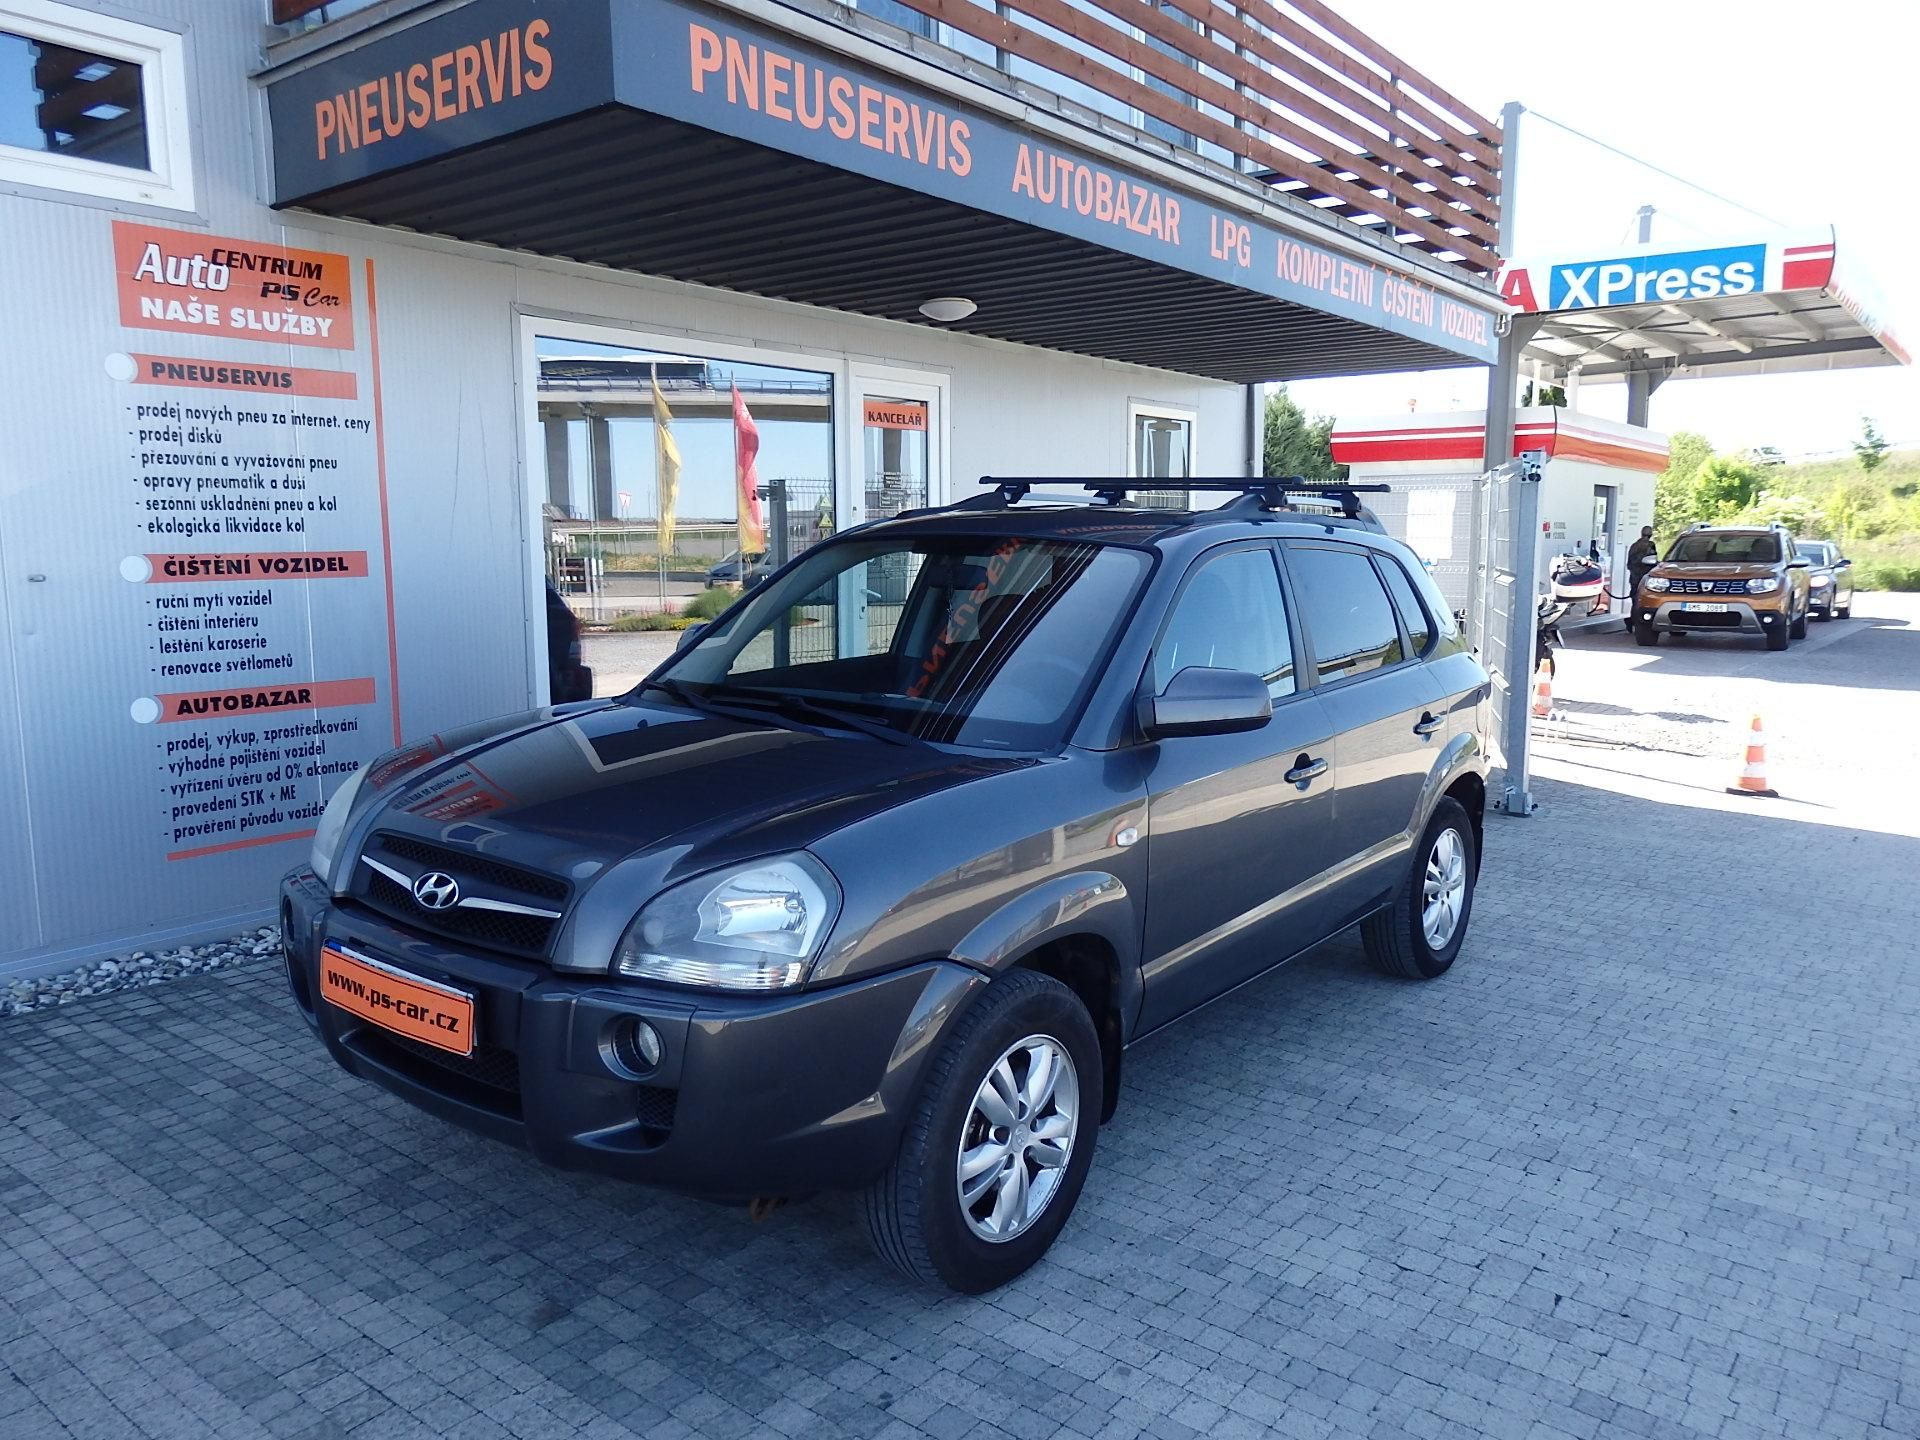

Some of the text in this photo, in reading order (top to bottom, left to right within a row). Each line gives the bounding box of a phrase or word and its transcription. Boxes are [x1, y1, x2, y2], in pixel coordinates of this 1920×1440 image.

[315, 18, 553, 160] PNEUSERVIS
[688, 22, 972, 177] PNEUSERVIS
[1012, 143, 1181, 247] AUTOBAZAR
[1210, 214, 1251, 268] LPG
[133, 241, 323, 292] Auto CENTRUM
[260, 282, 341, 307] PS Car
[1277, 238, 1488, 347] KOMPLETNÍ ČIŠTĚNÍ VOZIDEL
[1558, 261, 1755, 309] XPress
[140, 295, 333, 337] NAŠE SLUŽBY
[151, 361, 293, 388] PNEUSERVIS
[138, 402, 370, 433] prodej nových pneu za internet. ceny
[868, 411, 921, 425] KANCELÁŘ
[140, 425, 183, 446] prodej
[142, 451, 337, 472] přezouvání a vyvažování pneu
[144, 475, 191, 491] opravy
[198, 474, 265, 491] pneumatik
[271, 479, 277, 489] a
[275, 500, 303, 514] pneu
[308, 502, 314, 510] a
[319, 496, 337, 511] kol
[148, 517, 304, 537] ekologická likvidace kol
[164, 555, 349, 576] ČIŠTĚNÍ VOZIDEL
[156, 594, 189, 609] ruční
[229, 590, 272, 606] vozidel
[205, 613, 258, 630] interiéru
[160, 634, 267, 653] leštění karoserie
[162, 660, 222, 676] renovace
[177, 689, 311, 715] AUTOBAZAR
[167, 718, 358, 756] prodej, výkup, zprostředkování
[169, 741, 326, 777] výhodné pojištění vozidel
[171, 777, 223, 799] vyřízení
[267, 766, 280, 782] od
[285, 763, 302, 779] 0%
[307, 760, 358, 777] akontace
[173, 785, 296, 821] provedení STK + ME
[328, 970, 459, 1033] www.ps-car.cz
